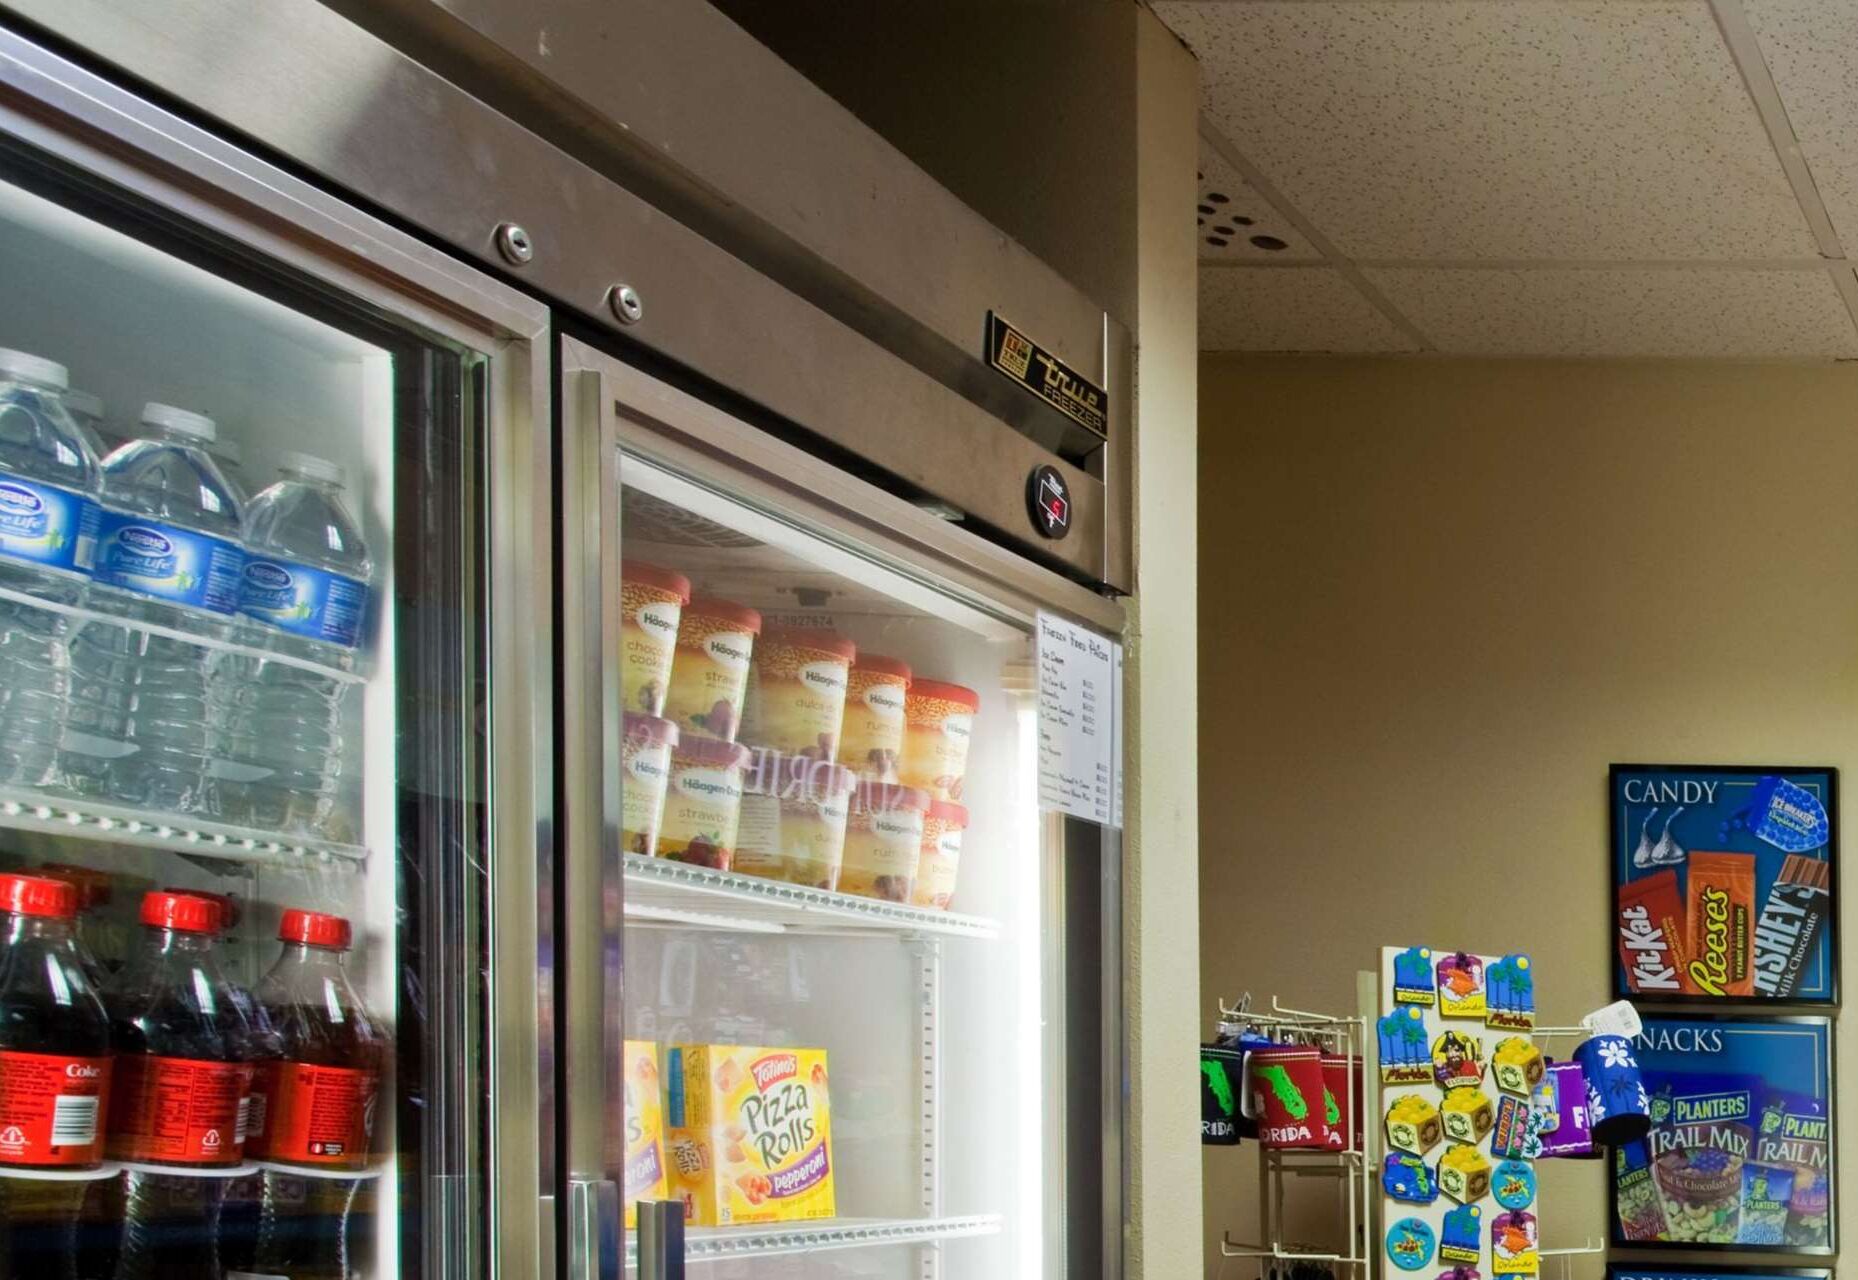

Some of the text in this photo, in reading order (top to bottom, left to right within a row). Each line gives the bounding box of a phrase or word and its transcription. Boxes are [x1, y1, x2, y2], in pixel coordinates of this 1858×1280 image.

[1044, 385, 1103, 431] FREEZER
[1624, 779, 1719, 805] CANDY
[1689, 884, 1730, 997] Reese's
[1777, 912, 1818, 998] Milk Chocolate
[741, 1084, 809, 1135] Pizza
[1676, 1096, 1746, 1122] PLANTERS
[755, 1118, 815, 1169] Rolls
[1202, 1120, 1235, 1135] RIDA
[1259, 1123, 1312, 1144] ORIDA
[1648, 1125, 1749, 1159] TRAIL MIX
[1785, 1117, 1826, 1138] PLANT
[774, 1147, 827, 1191] pepperoni
[1617, 1170, 1649, 1188] LANTERS
